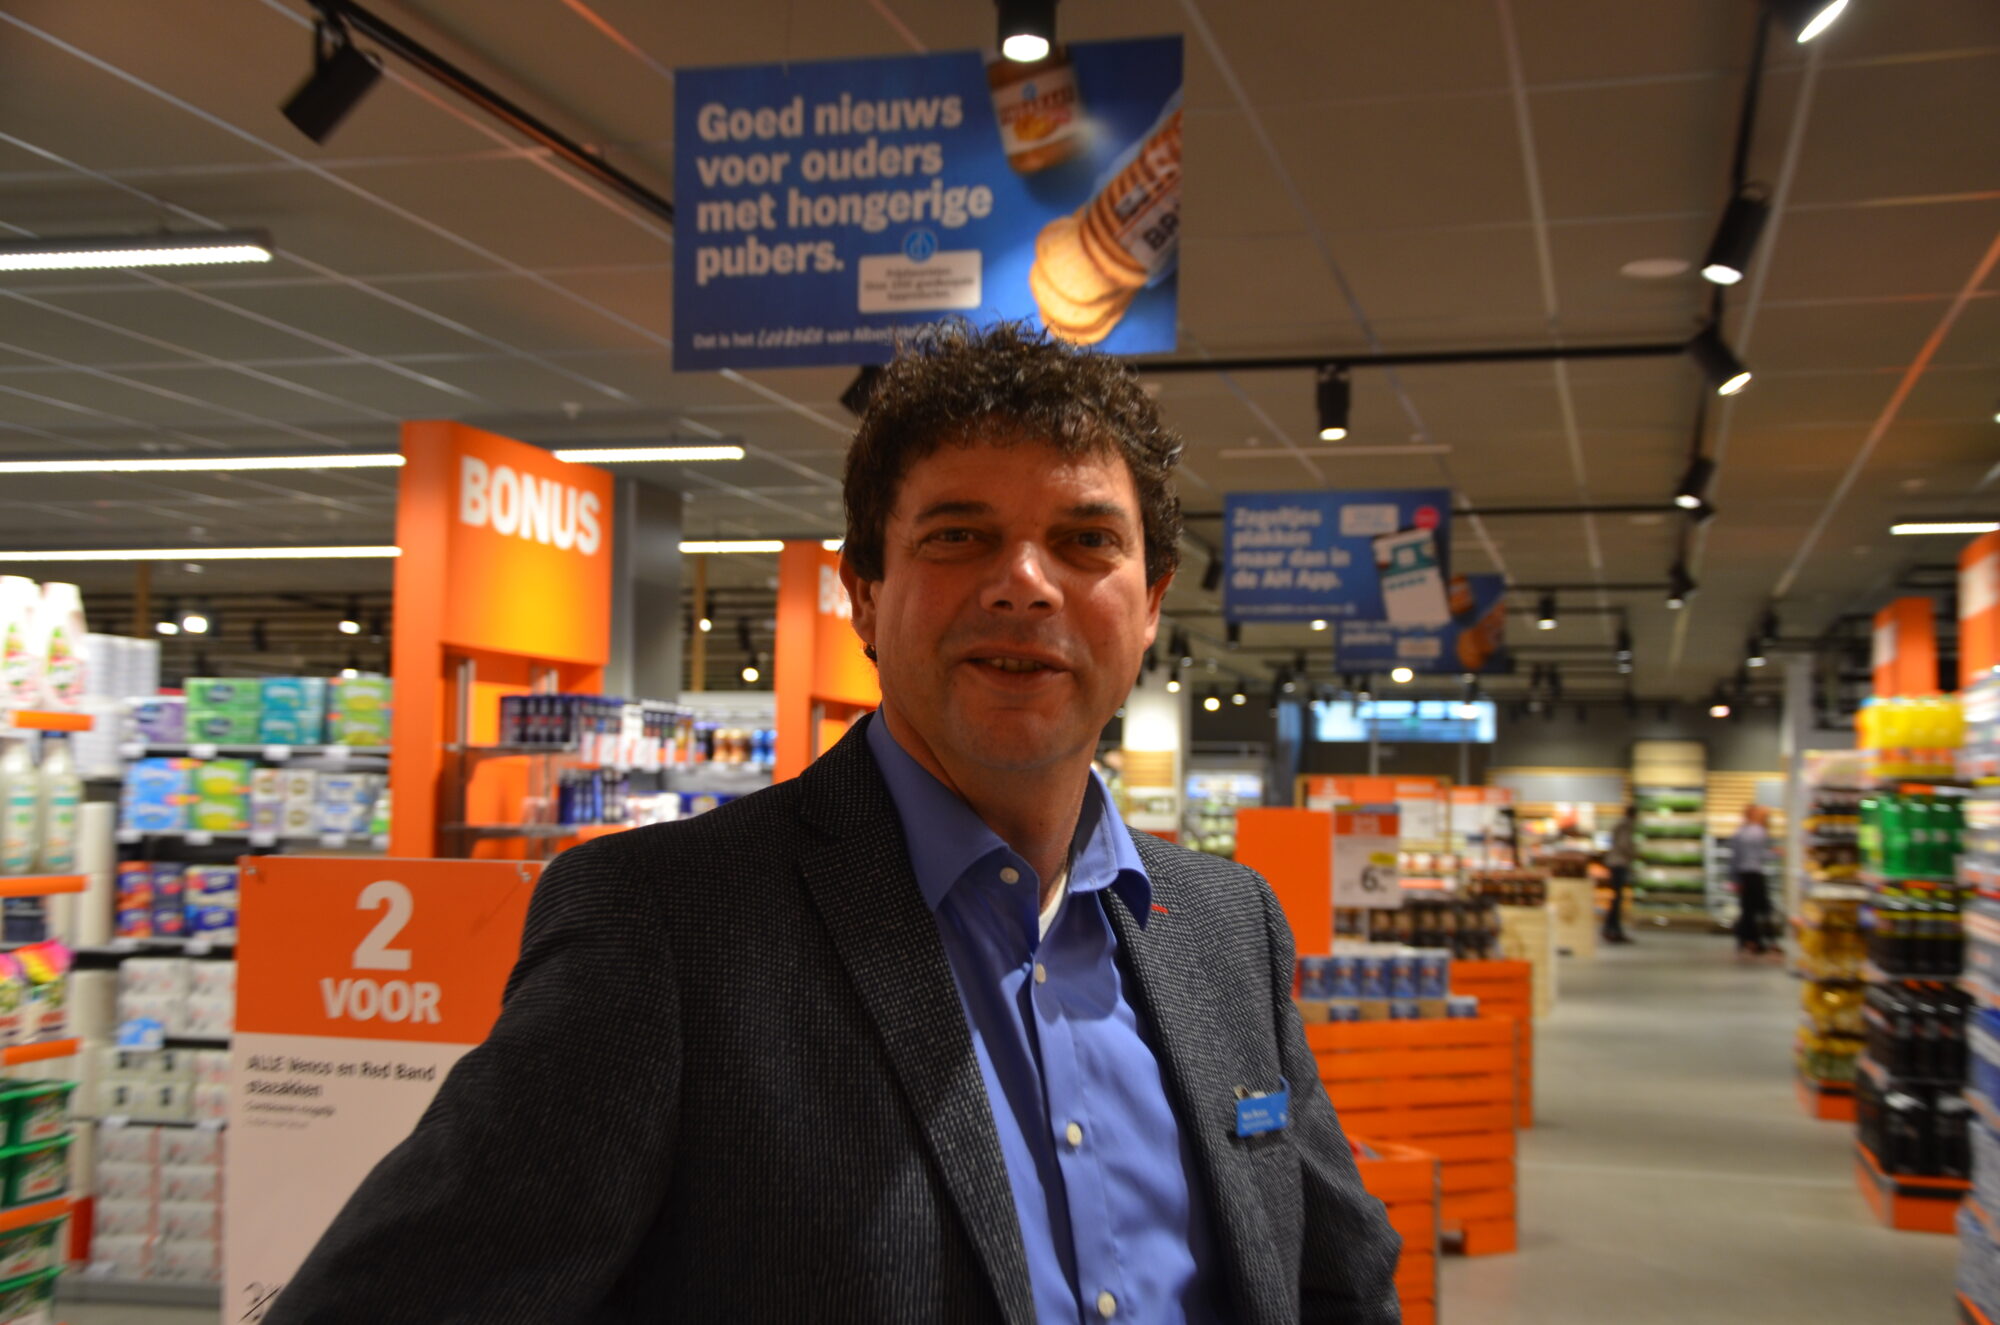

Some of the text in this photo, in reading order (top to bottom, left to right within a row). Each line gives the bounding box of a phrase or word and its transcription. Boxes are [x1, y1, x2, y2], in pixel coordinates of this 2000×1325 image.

[698, 97, 803, 142] Goed
[814, 92, 963, 136] nieuws
[697, 139, 944, 188] voor ouders
[698, 179, 994, 233] met hongerige
[696, 236, 844, 286] pubers.
[460, 454, 602, 557] BONUS
[1232, 571, 1257, 588] de
[1289, 549, 1327, 567] dan
[352, 880, 414, 970] 2
[320, 977, 442, 1024] VOOR
